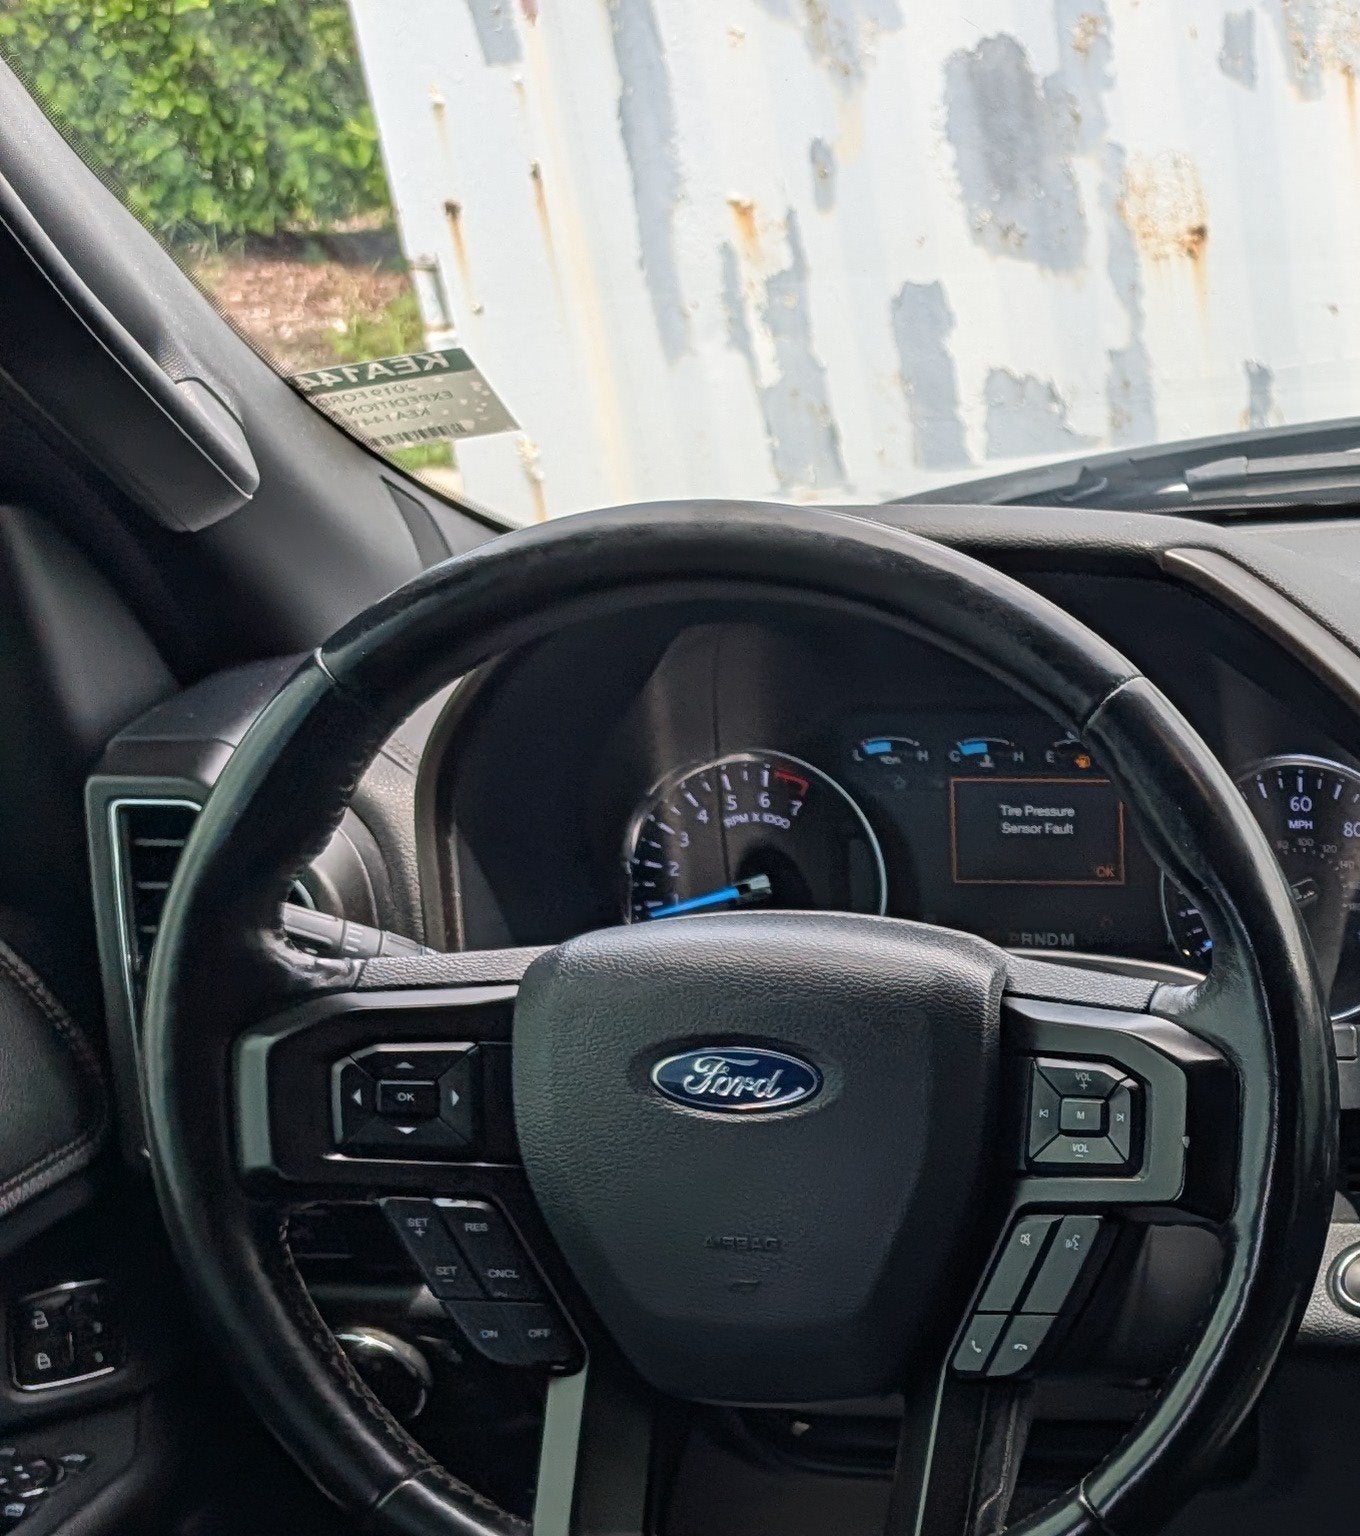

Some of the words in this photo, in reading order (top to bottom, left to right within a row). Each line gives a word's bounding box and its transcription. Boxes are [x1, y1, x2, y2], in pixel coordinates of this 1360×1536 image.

[727, 794, 738, 811] 5
[759, 790, 771, 808] 6
[1289, 797, 1312, 812] 60
[791, 800, 803, 816] 7
[1025, 805, 1075, 818] Pressure
[697, 809, 709, 824] 4
[1001, 822, 1042, 834] Sensor
[1045, 822, 1074, 835] Fault
[1288, 819, 1314, 830] MPH
[679, 830, 690, 848] 3
[669, 861, 680, 877] 2
[682, 1055, 785, 1099] Ford
[1075, 1072, 1092, 1082] VOL
[397, 1092, 415, 1102] OK
[1072, 1144, 1089, 1153] VOL
[408, 1217, 429, 1227] SET
[465, 1223, 488, 1233] RES
[436, 1266, 457, 1276] SET
